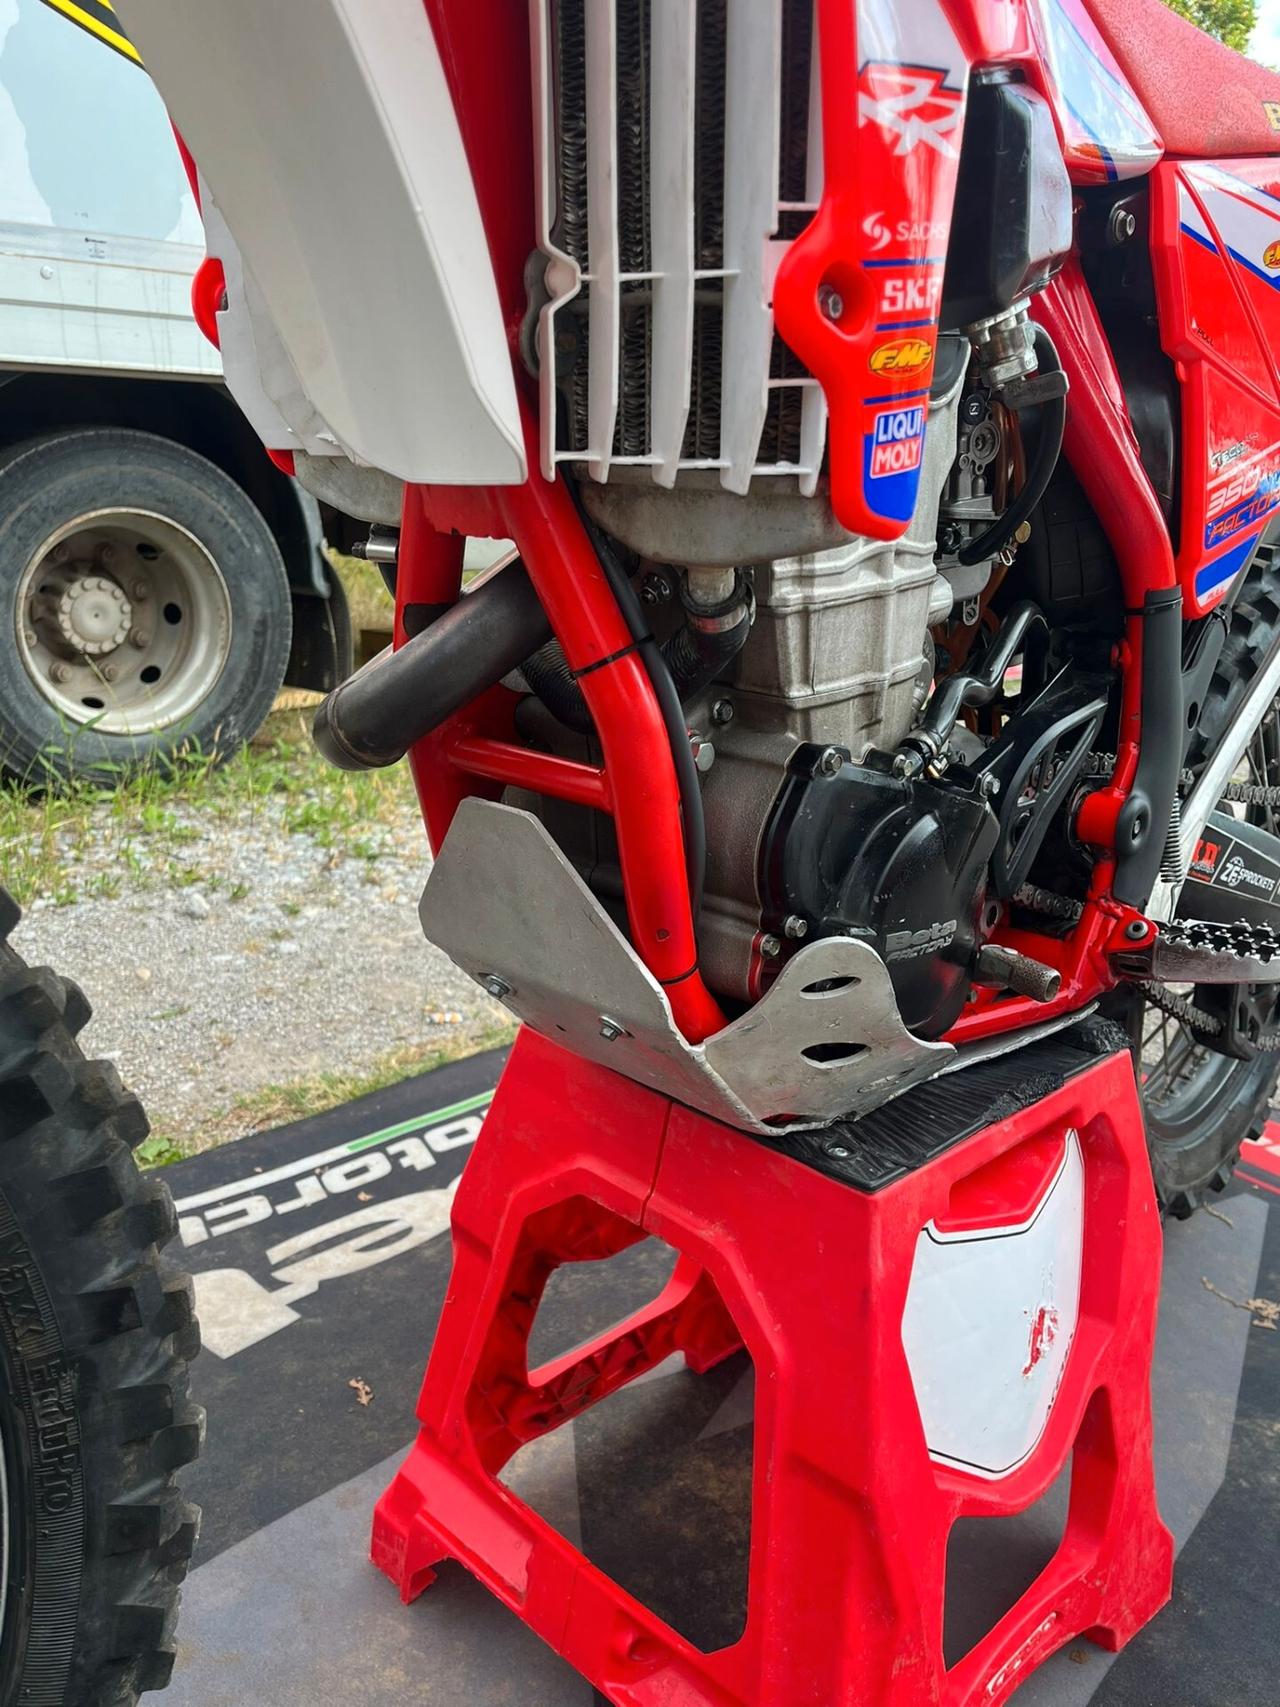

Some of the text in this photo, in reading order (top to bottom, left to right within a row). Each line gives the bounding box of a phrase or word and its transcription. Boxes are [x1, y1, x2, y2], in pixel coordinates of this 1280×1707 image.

[871, 344, 932, 370] FMF
[877, 411, 923, 442] LIQUI
[874, 440, 920, 473] MOLY
[1240, 868, 1276, 892] SPROCKETS
[886, 920, 957, 952] Beta
[886, 934, 954, 963] FACTORY
[178, 1109, 490, 1248] otorc
